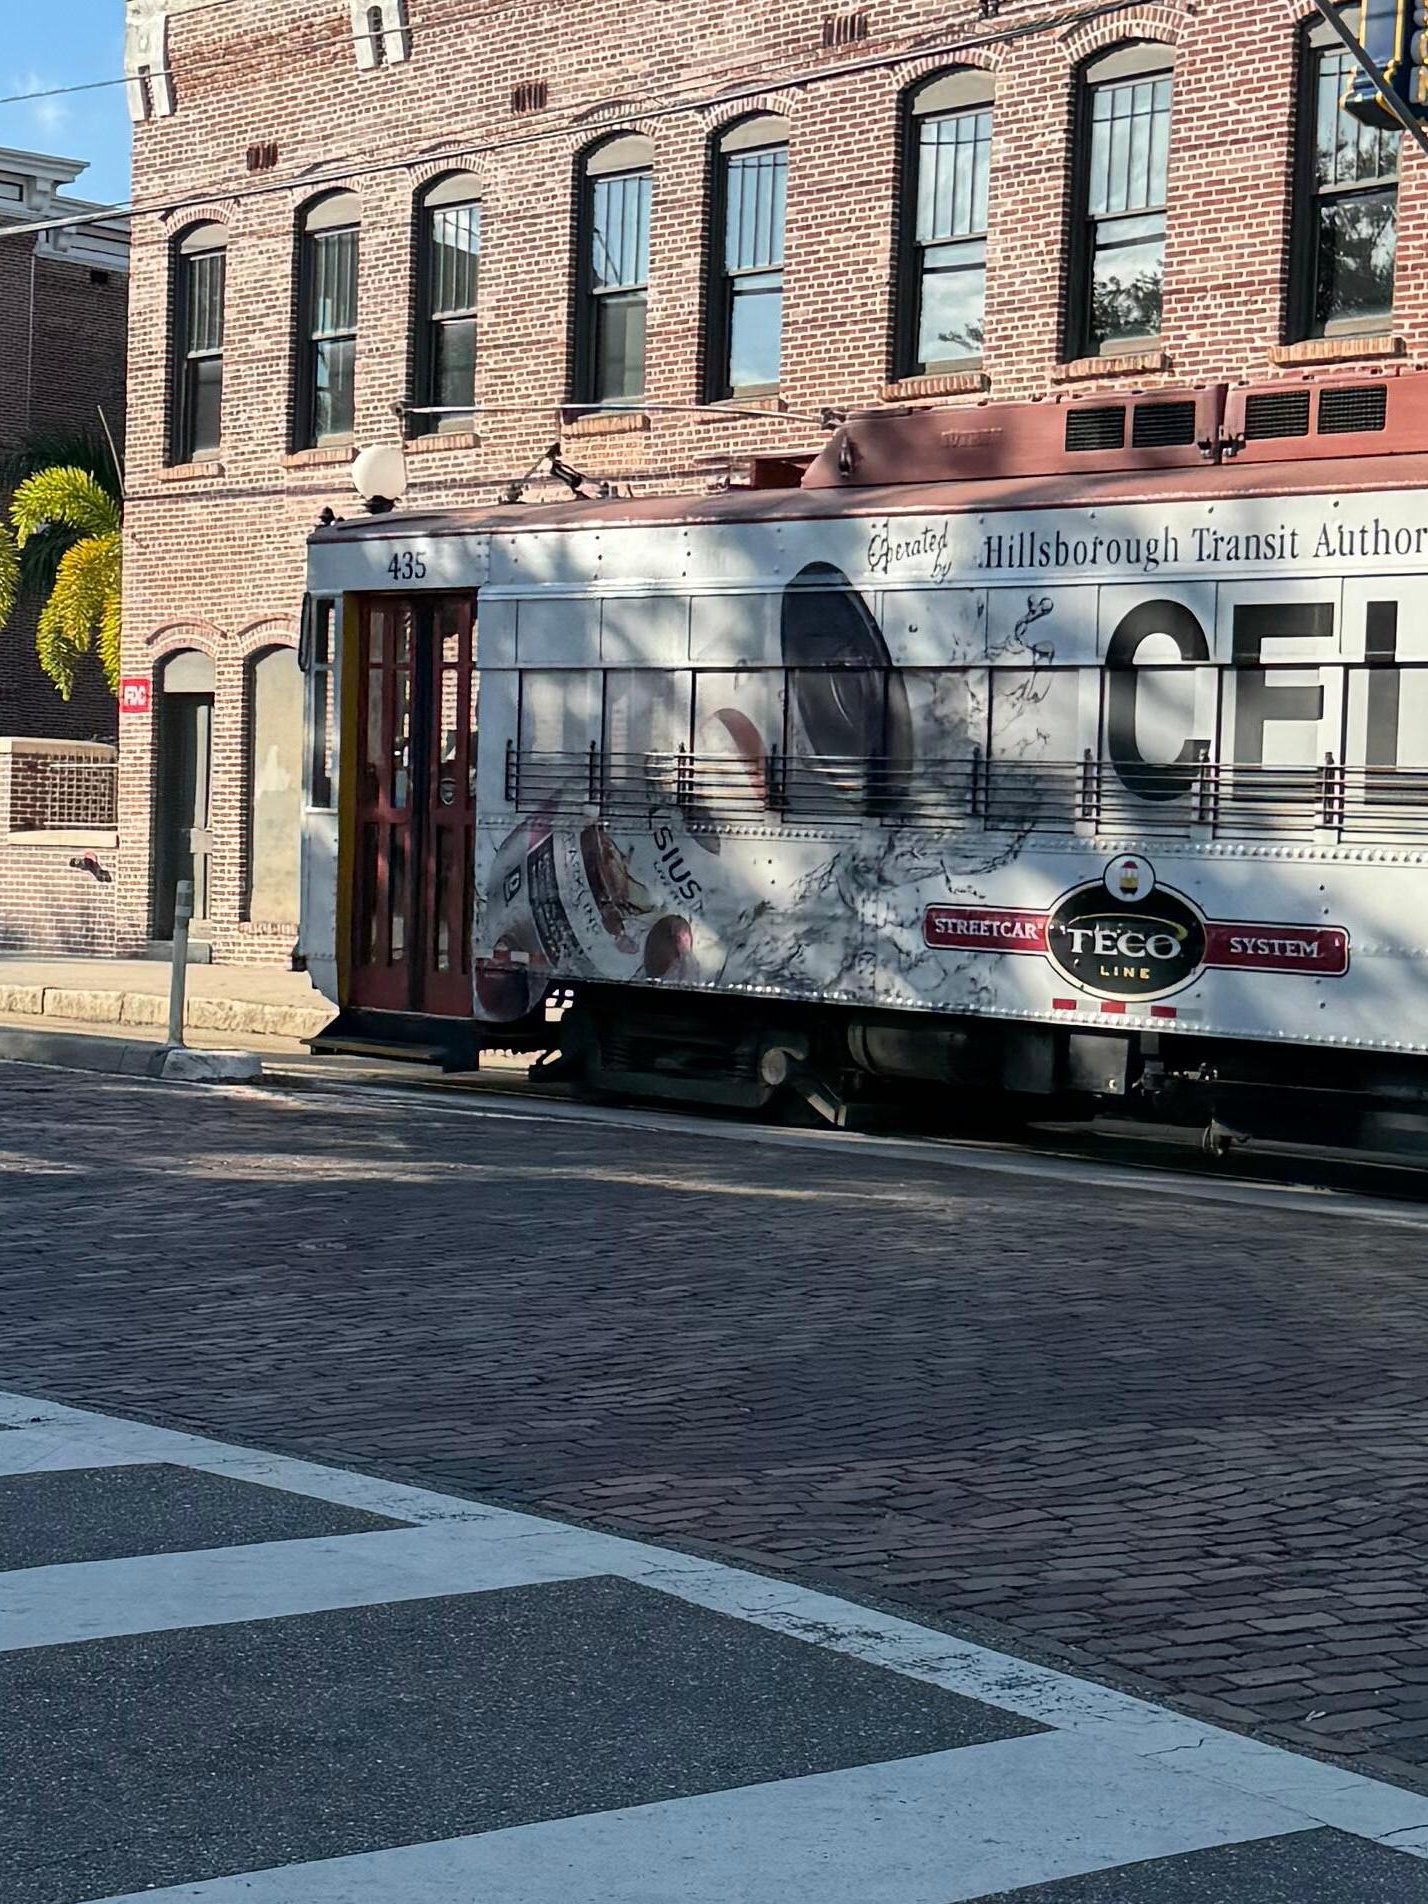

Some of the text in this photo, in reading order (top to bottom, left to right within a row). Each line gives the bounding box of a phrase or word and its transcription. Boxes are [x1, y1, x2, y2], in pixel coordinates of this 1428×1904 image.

[982, 526, 1179, 572] Hillsborough
[1191, 524, 1300, 562] Transit
[387, 551, 427, 580] 435
[931, 554, 952, 584] by
[934, 918, 1040, 940] STREETCAR
[1067, 926, 1182, 961] TECO
[1229, 936, 1319, 959] SYSTEM
[1099, 964, 1151, 980] LINE
